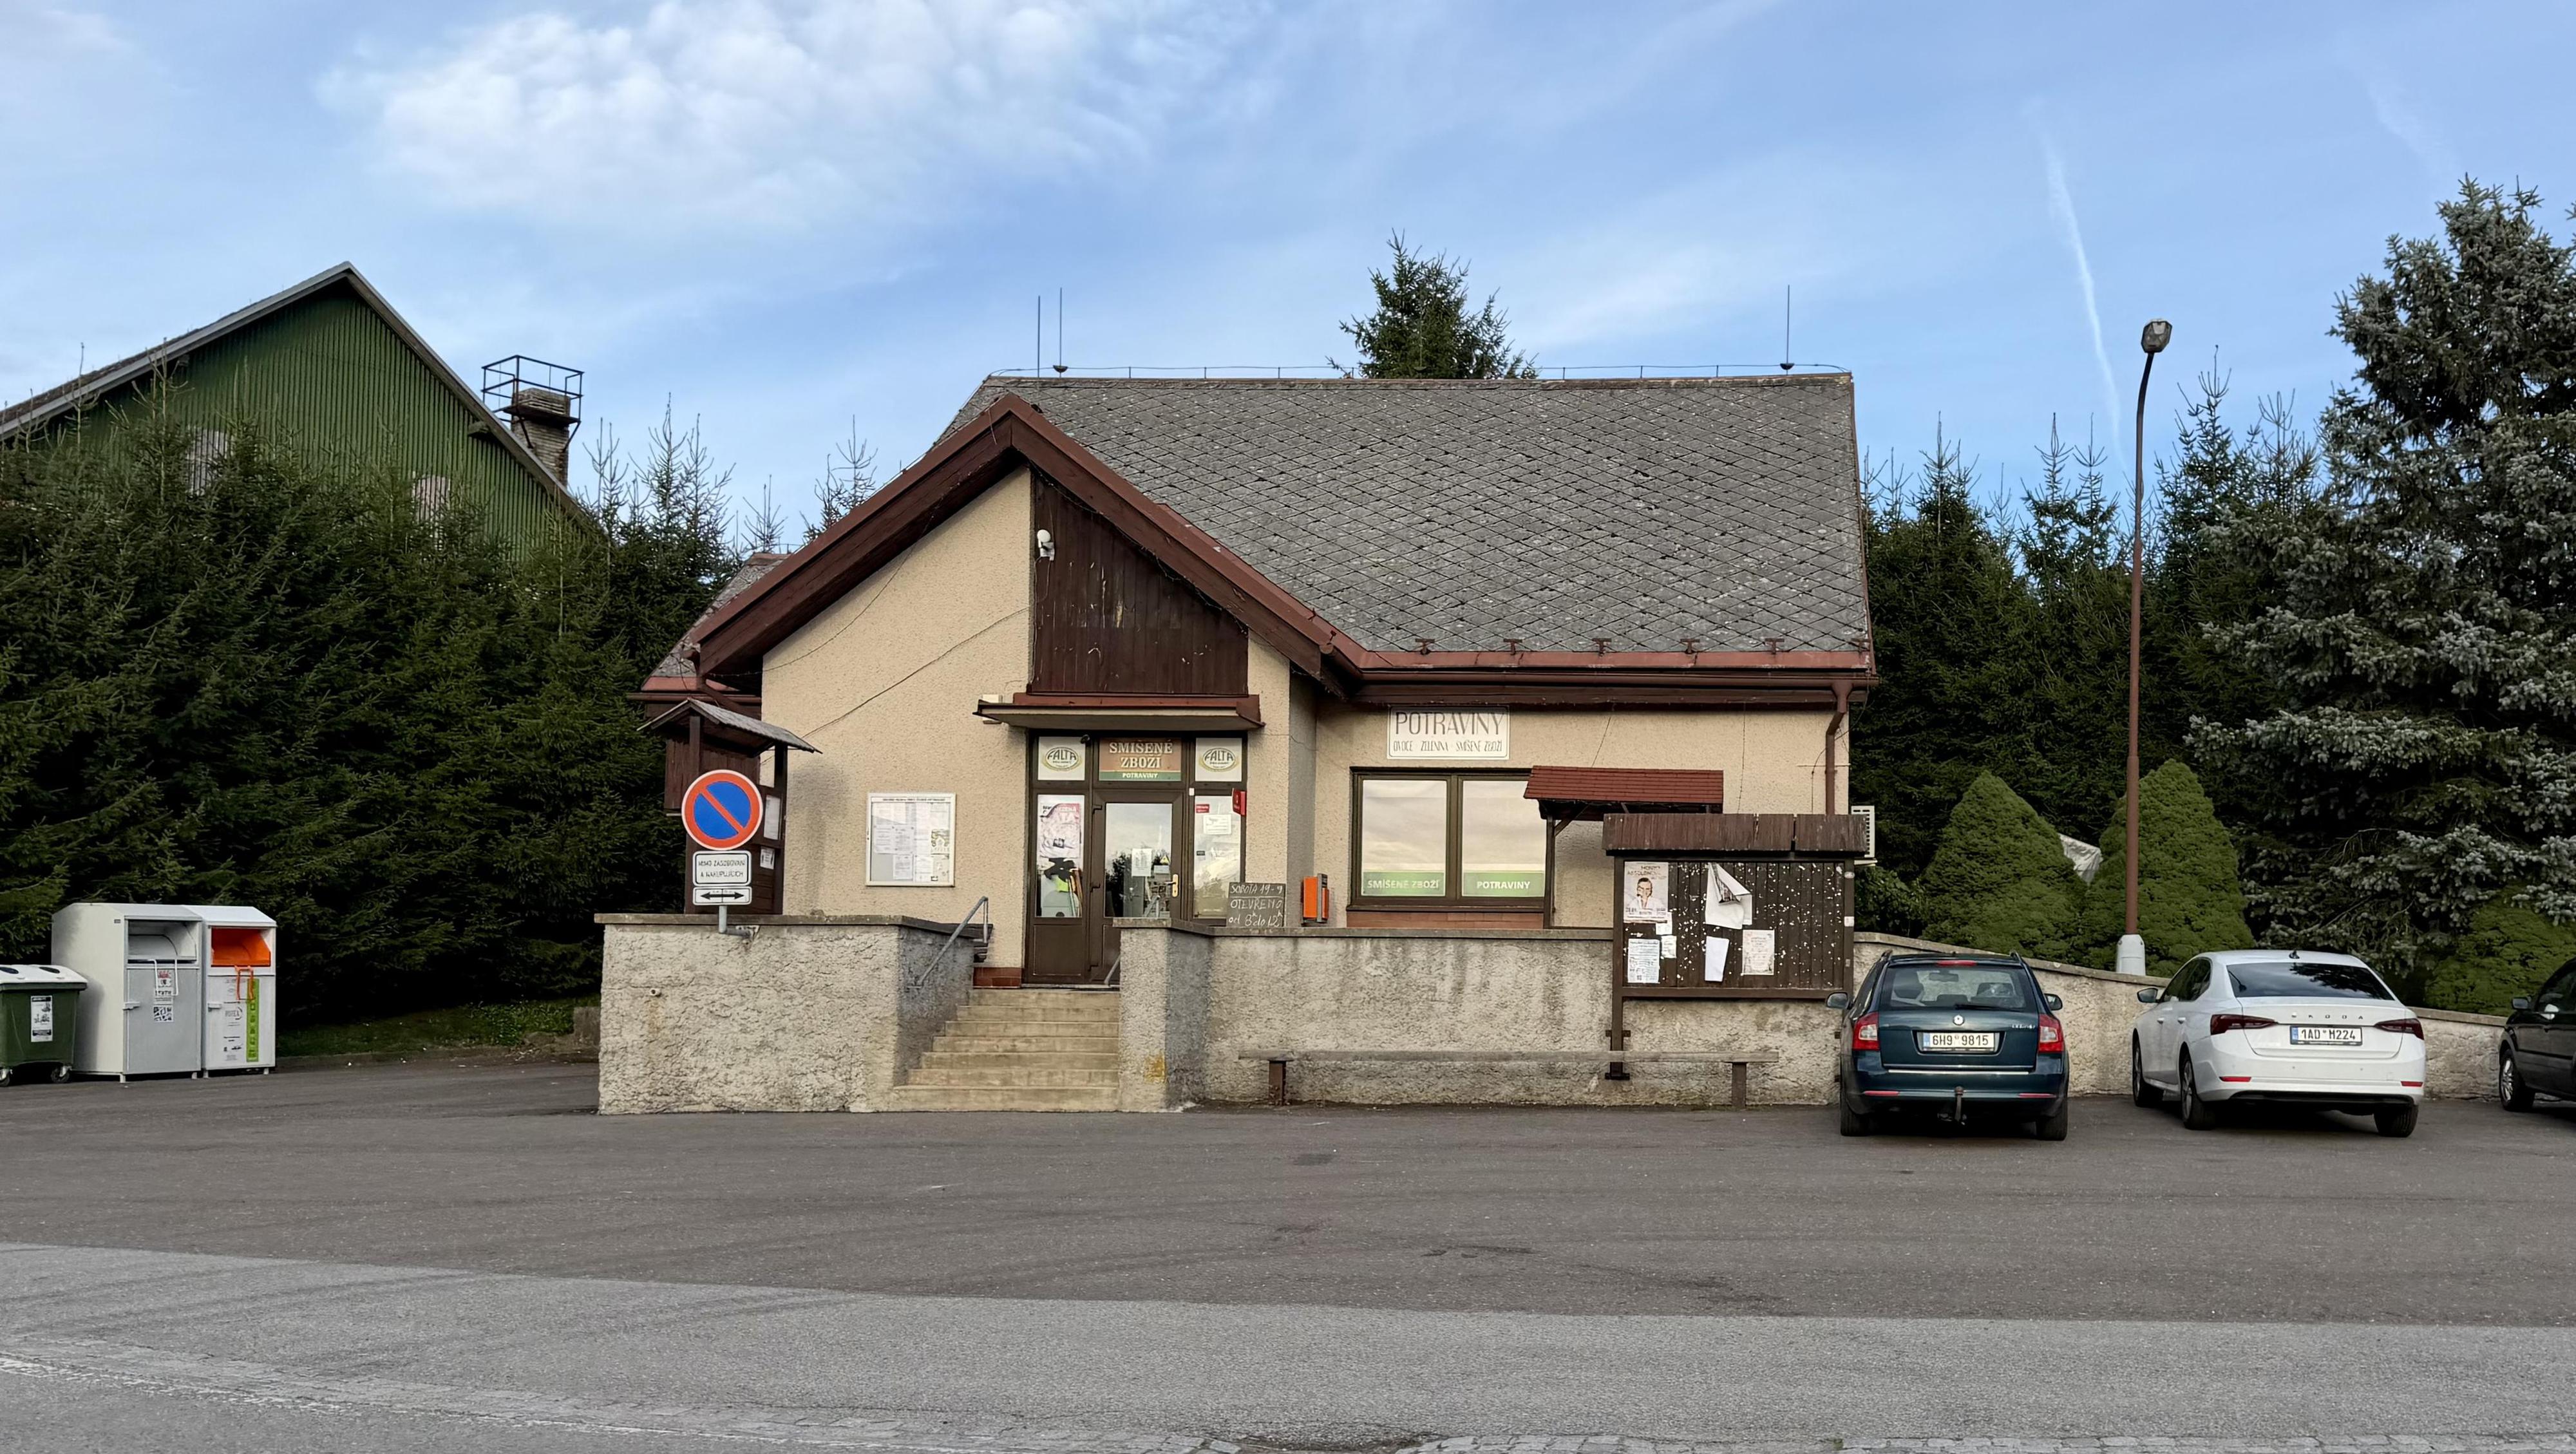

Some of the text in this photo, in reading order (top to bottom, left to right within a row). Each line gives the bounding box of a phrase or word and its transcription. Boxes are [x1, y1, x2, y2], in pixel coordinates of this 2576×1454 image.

[1396, 712, 1504, 735] POTRAVINY
[1393, 741, 1413, 752] OVOCE
[1047, 749, 1077, 760] FALTA
[1204, 750, 1234, 761] FALTA
[1230, 884, 1258, 894] SOBOTA
[1477, 881, 1530, 889] POTRAVINY
[1228, 914, 1241, 924] od
[1253, 914, 1266, 926] do
[2301, 1029, 2356, 1040] 1AD H224
[1933, 1035, 1989, 1046] 6H9 9815
